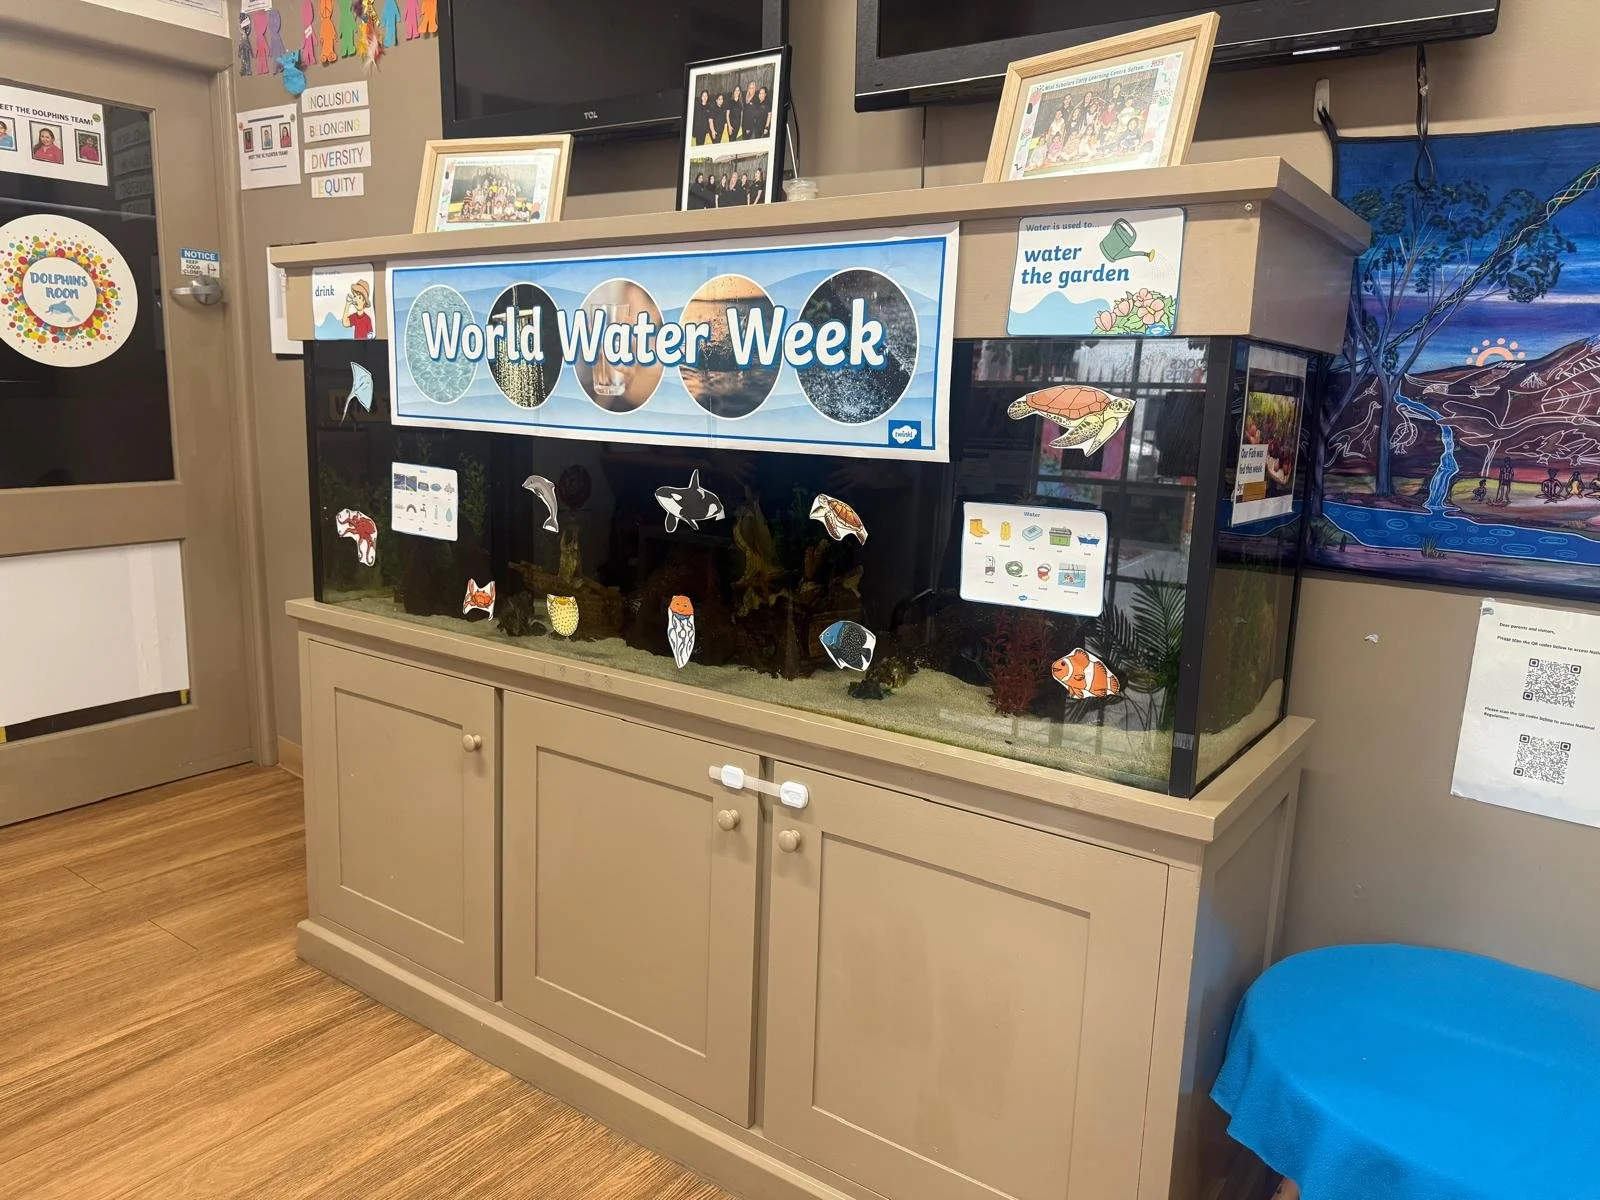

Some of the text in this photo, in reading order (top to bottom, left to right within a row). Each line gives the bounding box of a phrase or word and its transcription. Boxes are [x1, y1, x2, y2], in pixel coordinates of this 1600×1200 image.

[0, 103, 93, 126] EET THE DOLPHINS TEAM!
[584, 112, 598, 120] TCL
[311, 147, 364, 169] DIVERSITY
[317, 176, 356, 195] EQUITY
[1026, 221, 1100, 232] Water is used to...
[184, 250, 216, 260] NOTICE
[1024, 245, 1082, 262] water
[30, 272, 88, 287] DOLPHINS
[1021, 264, 1129, 289] the garden
[46, 287, 79, 299] ROOM
[315, 285, 335, 297] drink
[421, 297, 887, 368] World Water Week
[895, 430, 913, 438] twinkl
[1575, 722, 1595, 730] National
